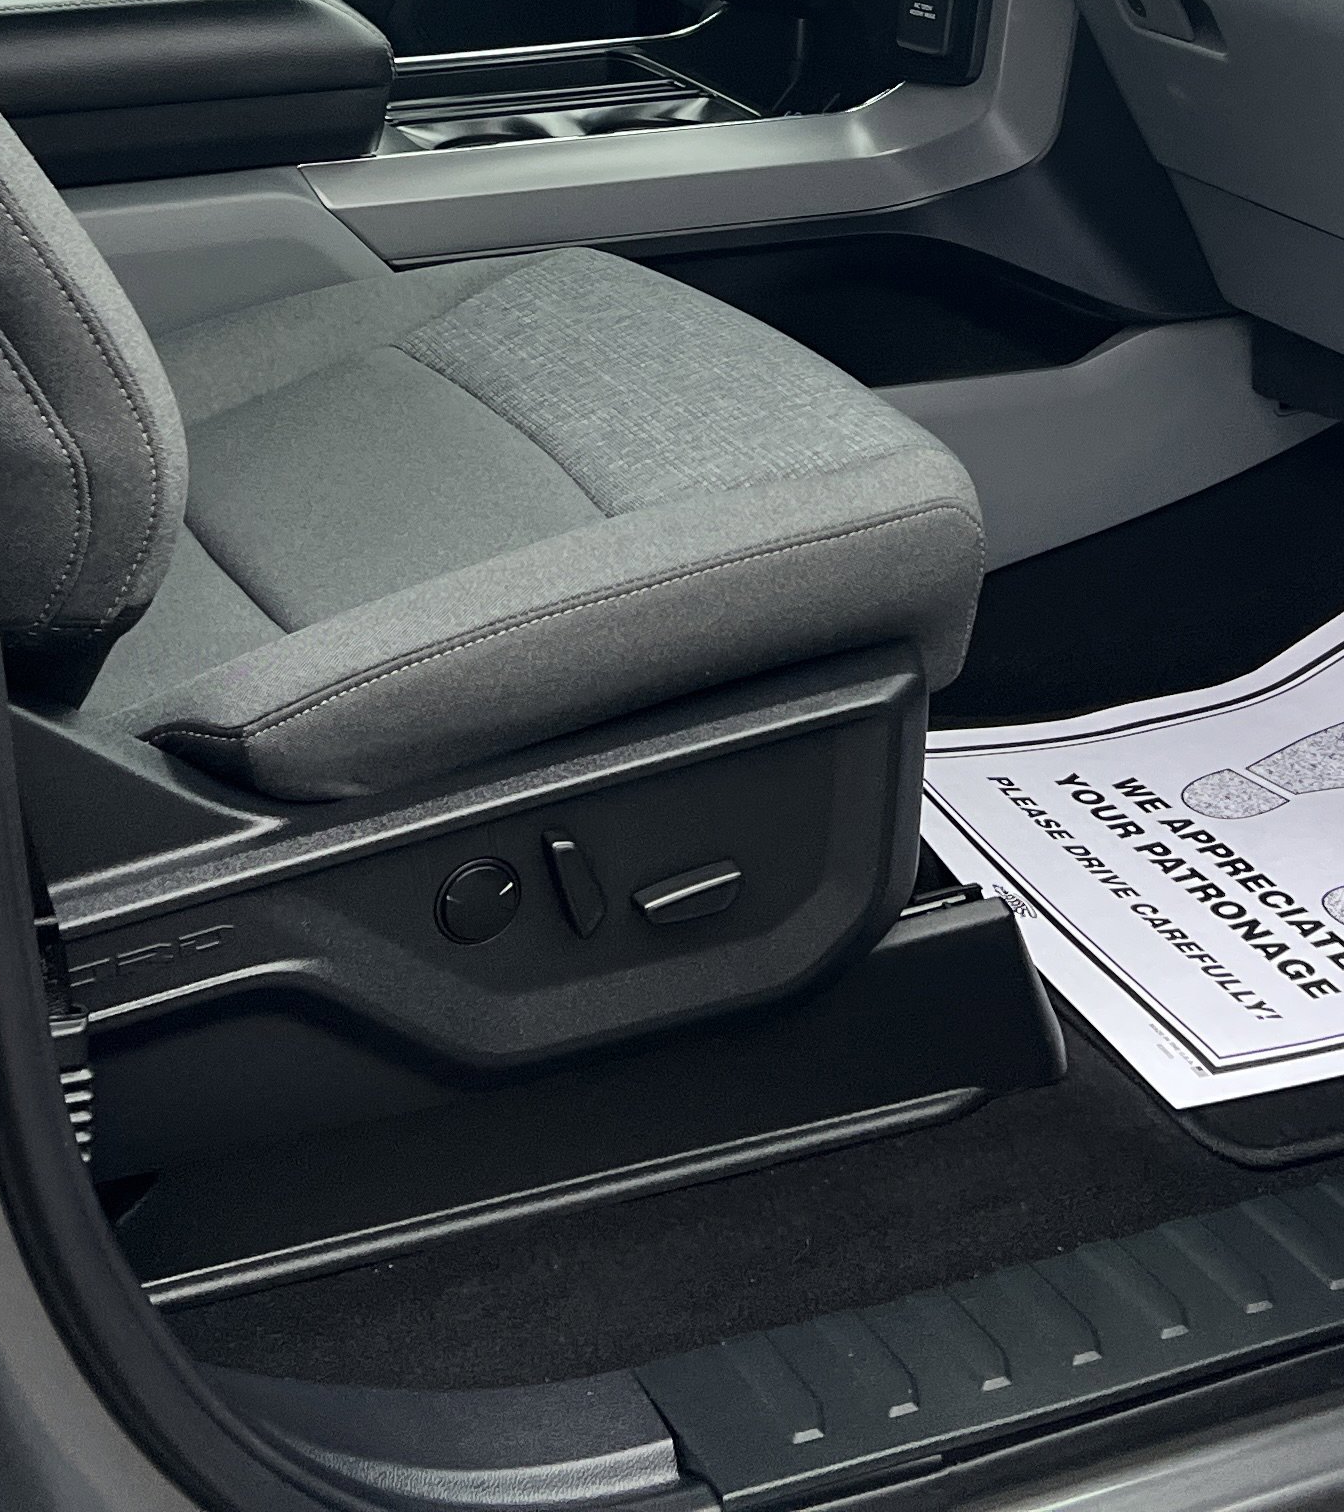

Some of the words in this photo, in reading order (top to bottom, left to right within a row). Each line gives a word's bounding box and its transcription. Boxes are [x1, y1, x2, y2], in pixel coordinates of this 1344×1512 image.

[987, 776, 1075, 840] PLEASE
[1062, 845, 1141, 900] DRIVE
[1130, 903, 1283, 1020] CAREFULLY!
[1055, 772, 1146, 839] YOUR
[1134, 841, 1343, 1000] PATRONAGE
[1112, 777, 1172, 814] WE
